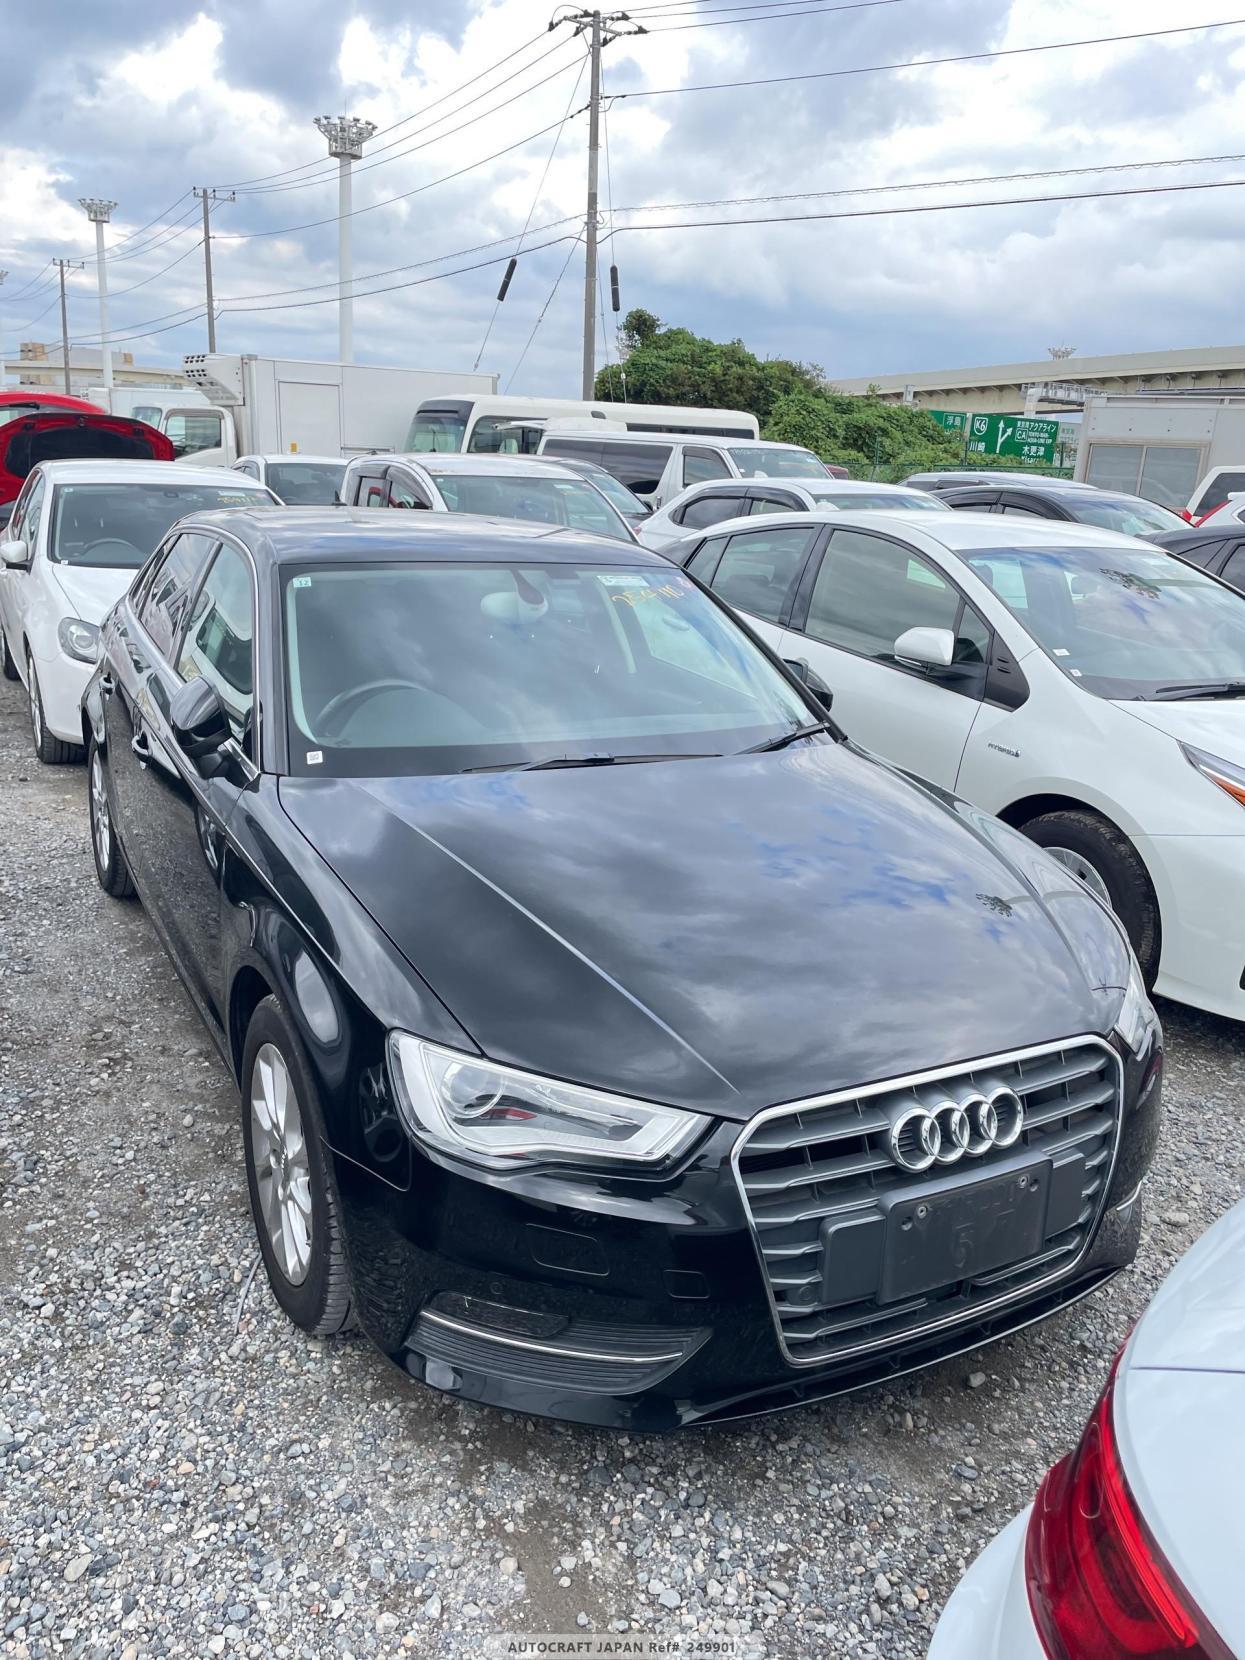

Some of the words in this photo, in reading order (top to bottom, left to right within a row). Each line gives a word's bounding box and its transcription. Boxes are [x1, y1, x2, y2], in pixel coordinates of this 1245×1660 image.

[975, 419, 986, 431] K6
[1017, 430, 1026, 440] CA
[1022, 445, 1044, 456] 木更津
